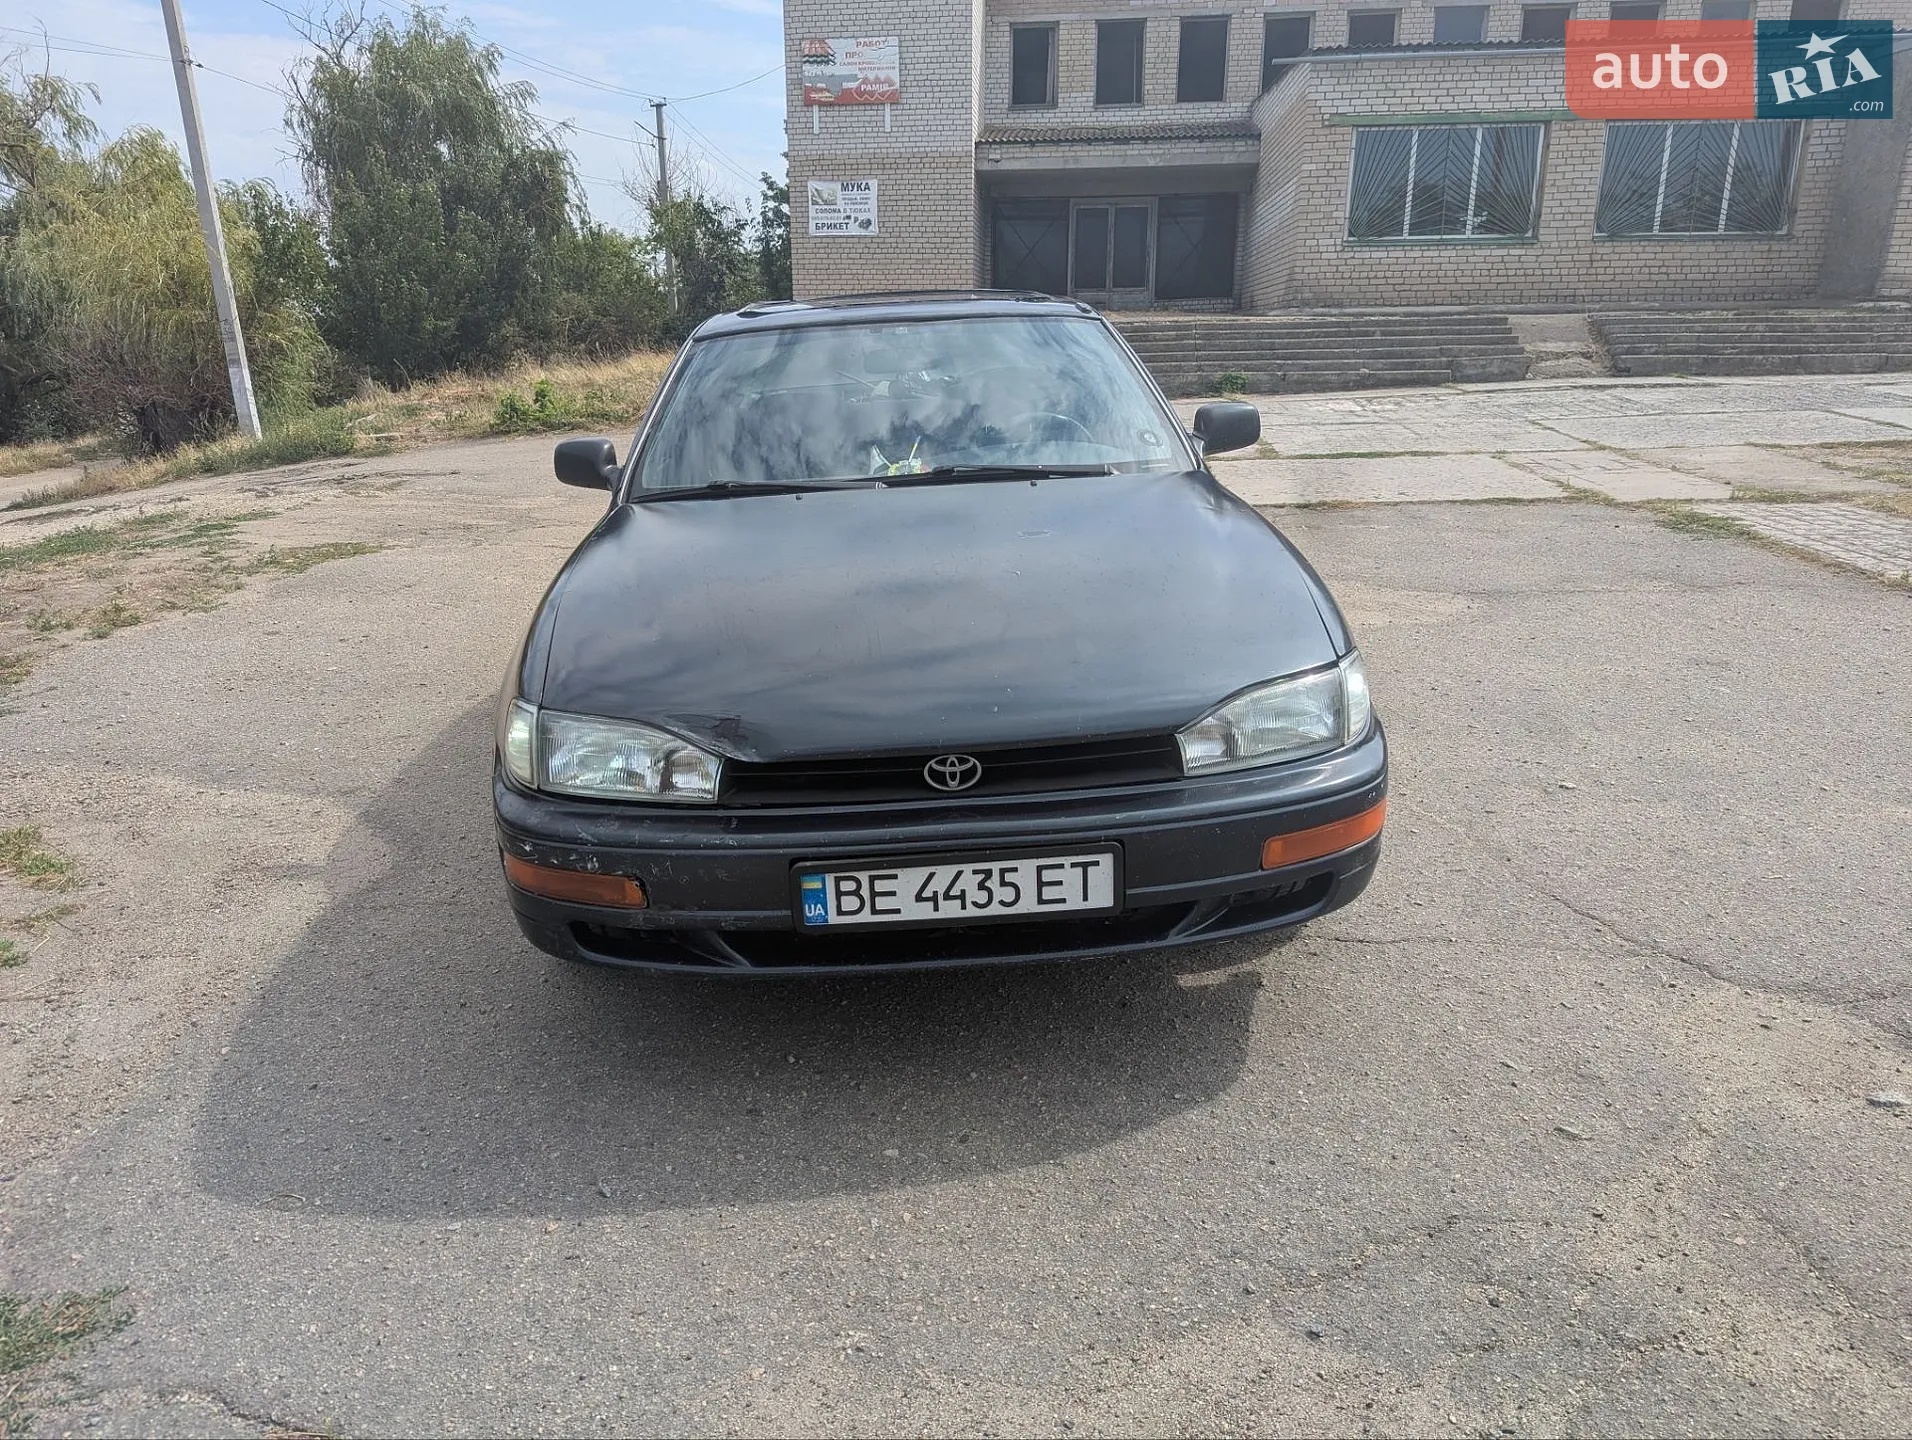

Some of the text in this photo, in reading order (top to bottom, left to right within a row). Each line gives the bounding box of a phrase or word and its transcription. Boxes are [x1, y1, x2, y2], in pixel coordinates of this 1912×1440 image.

[840, 182, 871, 192] МУКА
[815, 222, 850, 230] БРИКЕТ
[834, 860, 1100, 917] BE 4435 ET
[805, 903, 826, 918] UA
